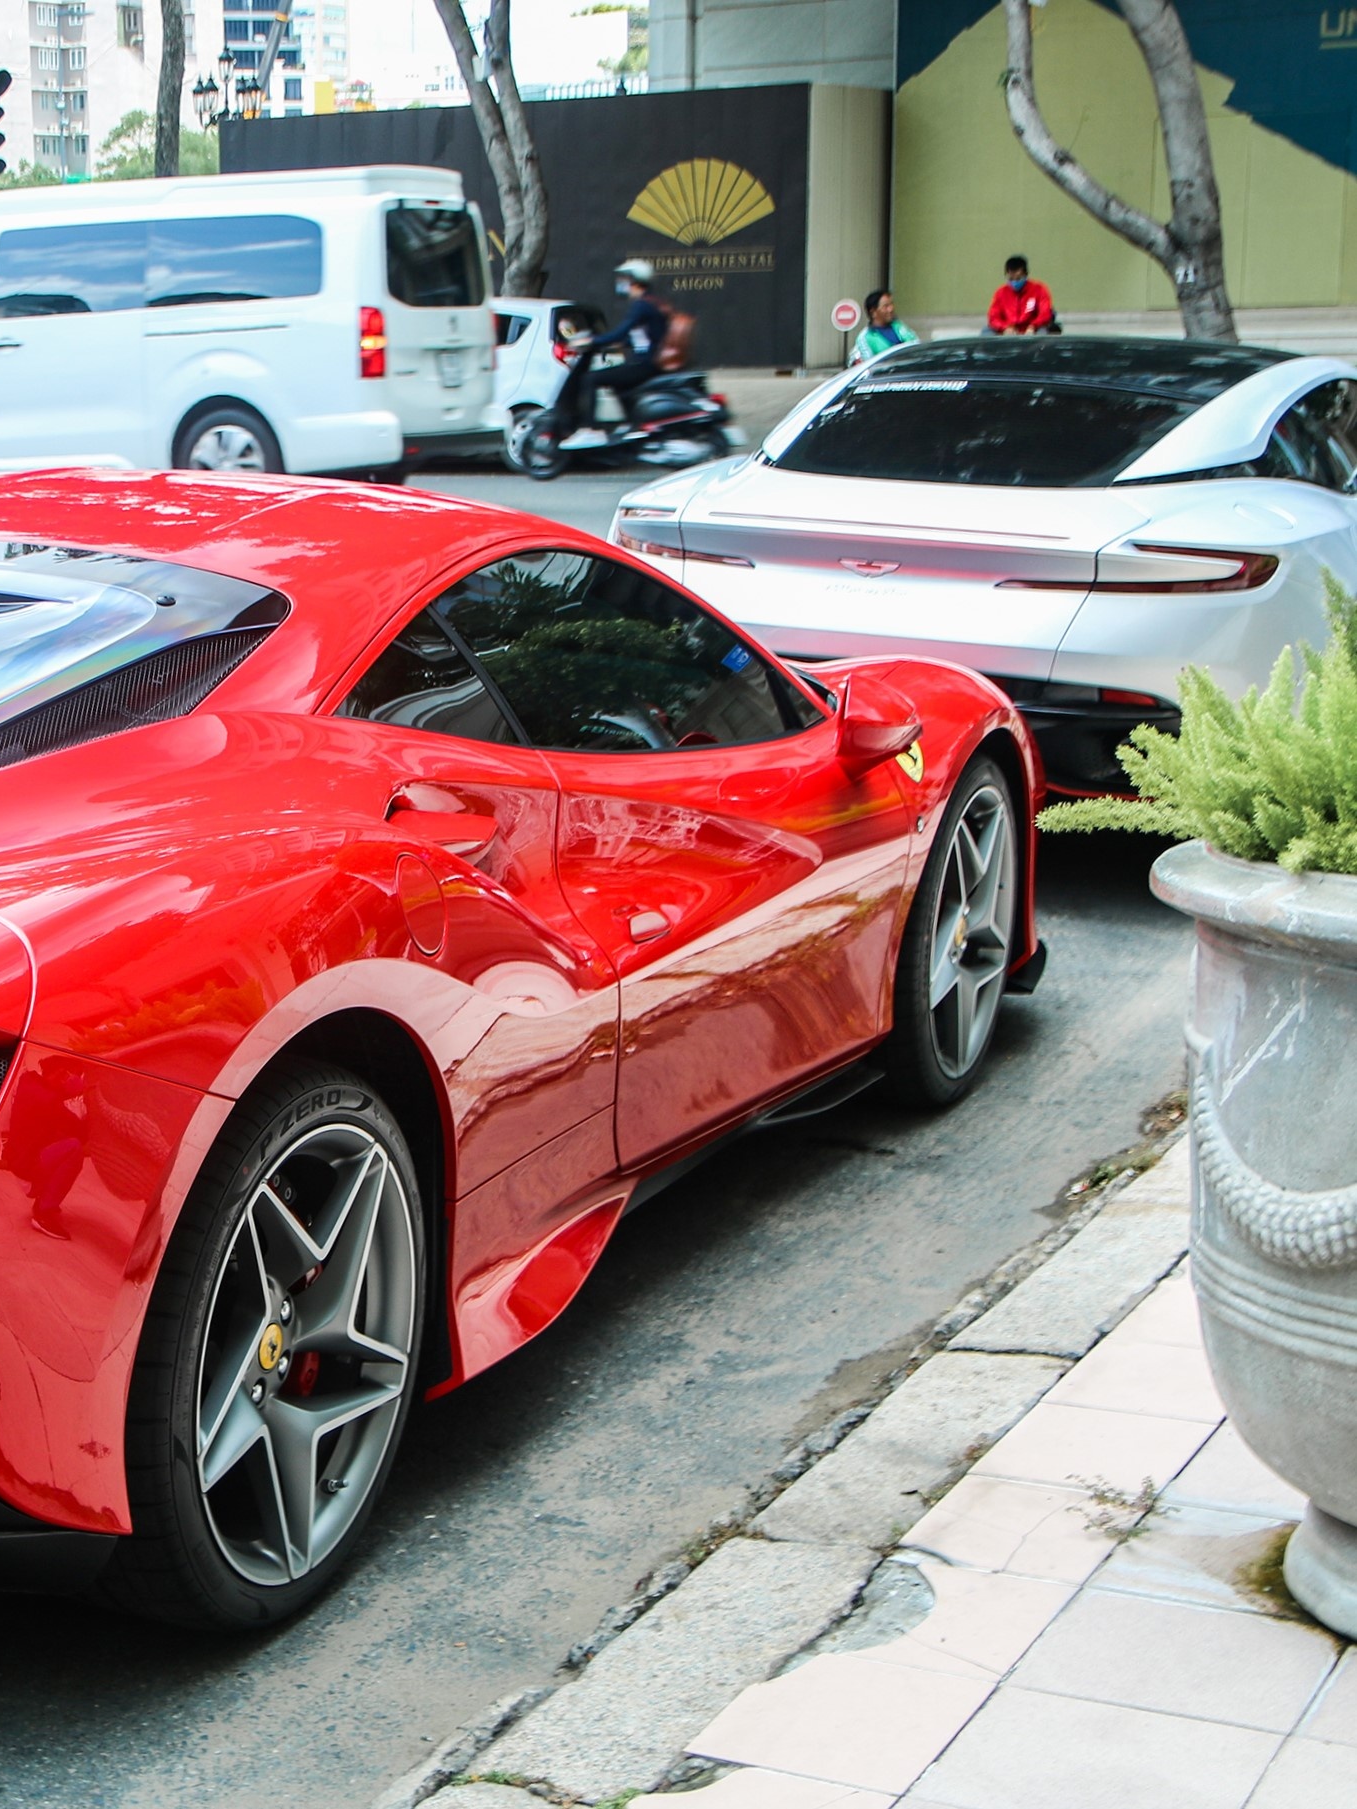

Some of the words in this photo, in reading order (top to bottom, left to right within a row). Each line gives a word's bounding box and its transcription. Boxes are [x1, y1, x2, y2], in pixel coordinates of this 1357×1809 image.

[701, 253, 774, 268] ORIENTAL
[672, 277, 725, 291] SAIGON
[258, 1131, 274, 1162] P
[280, 1089, 342, 1137] ZERO
